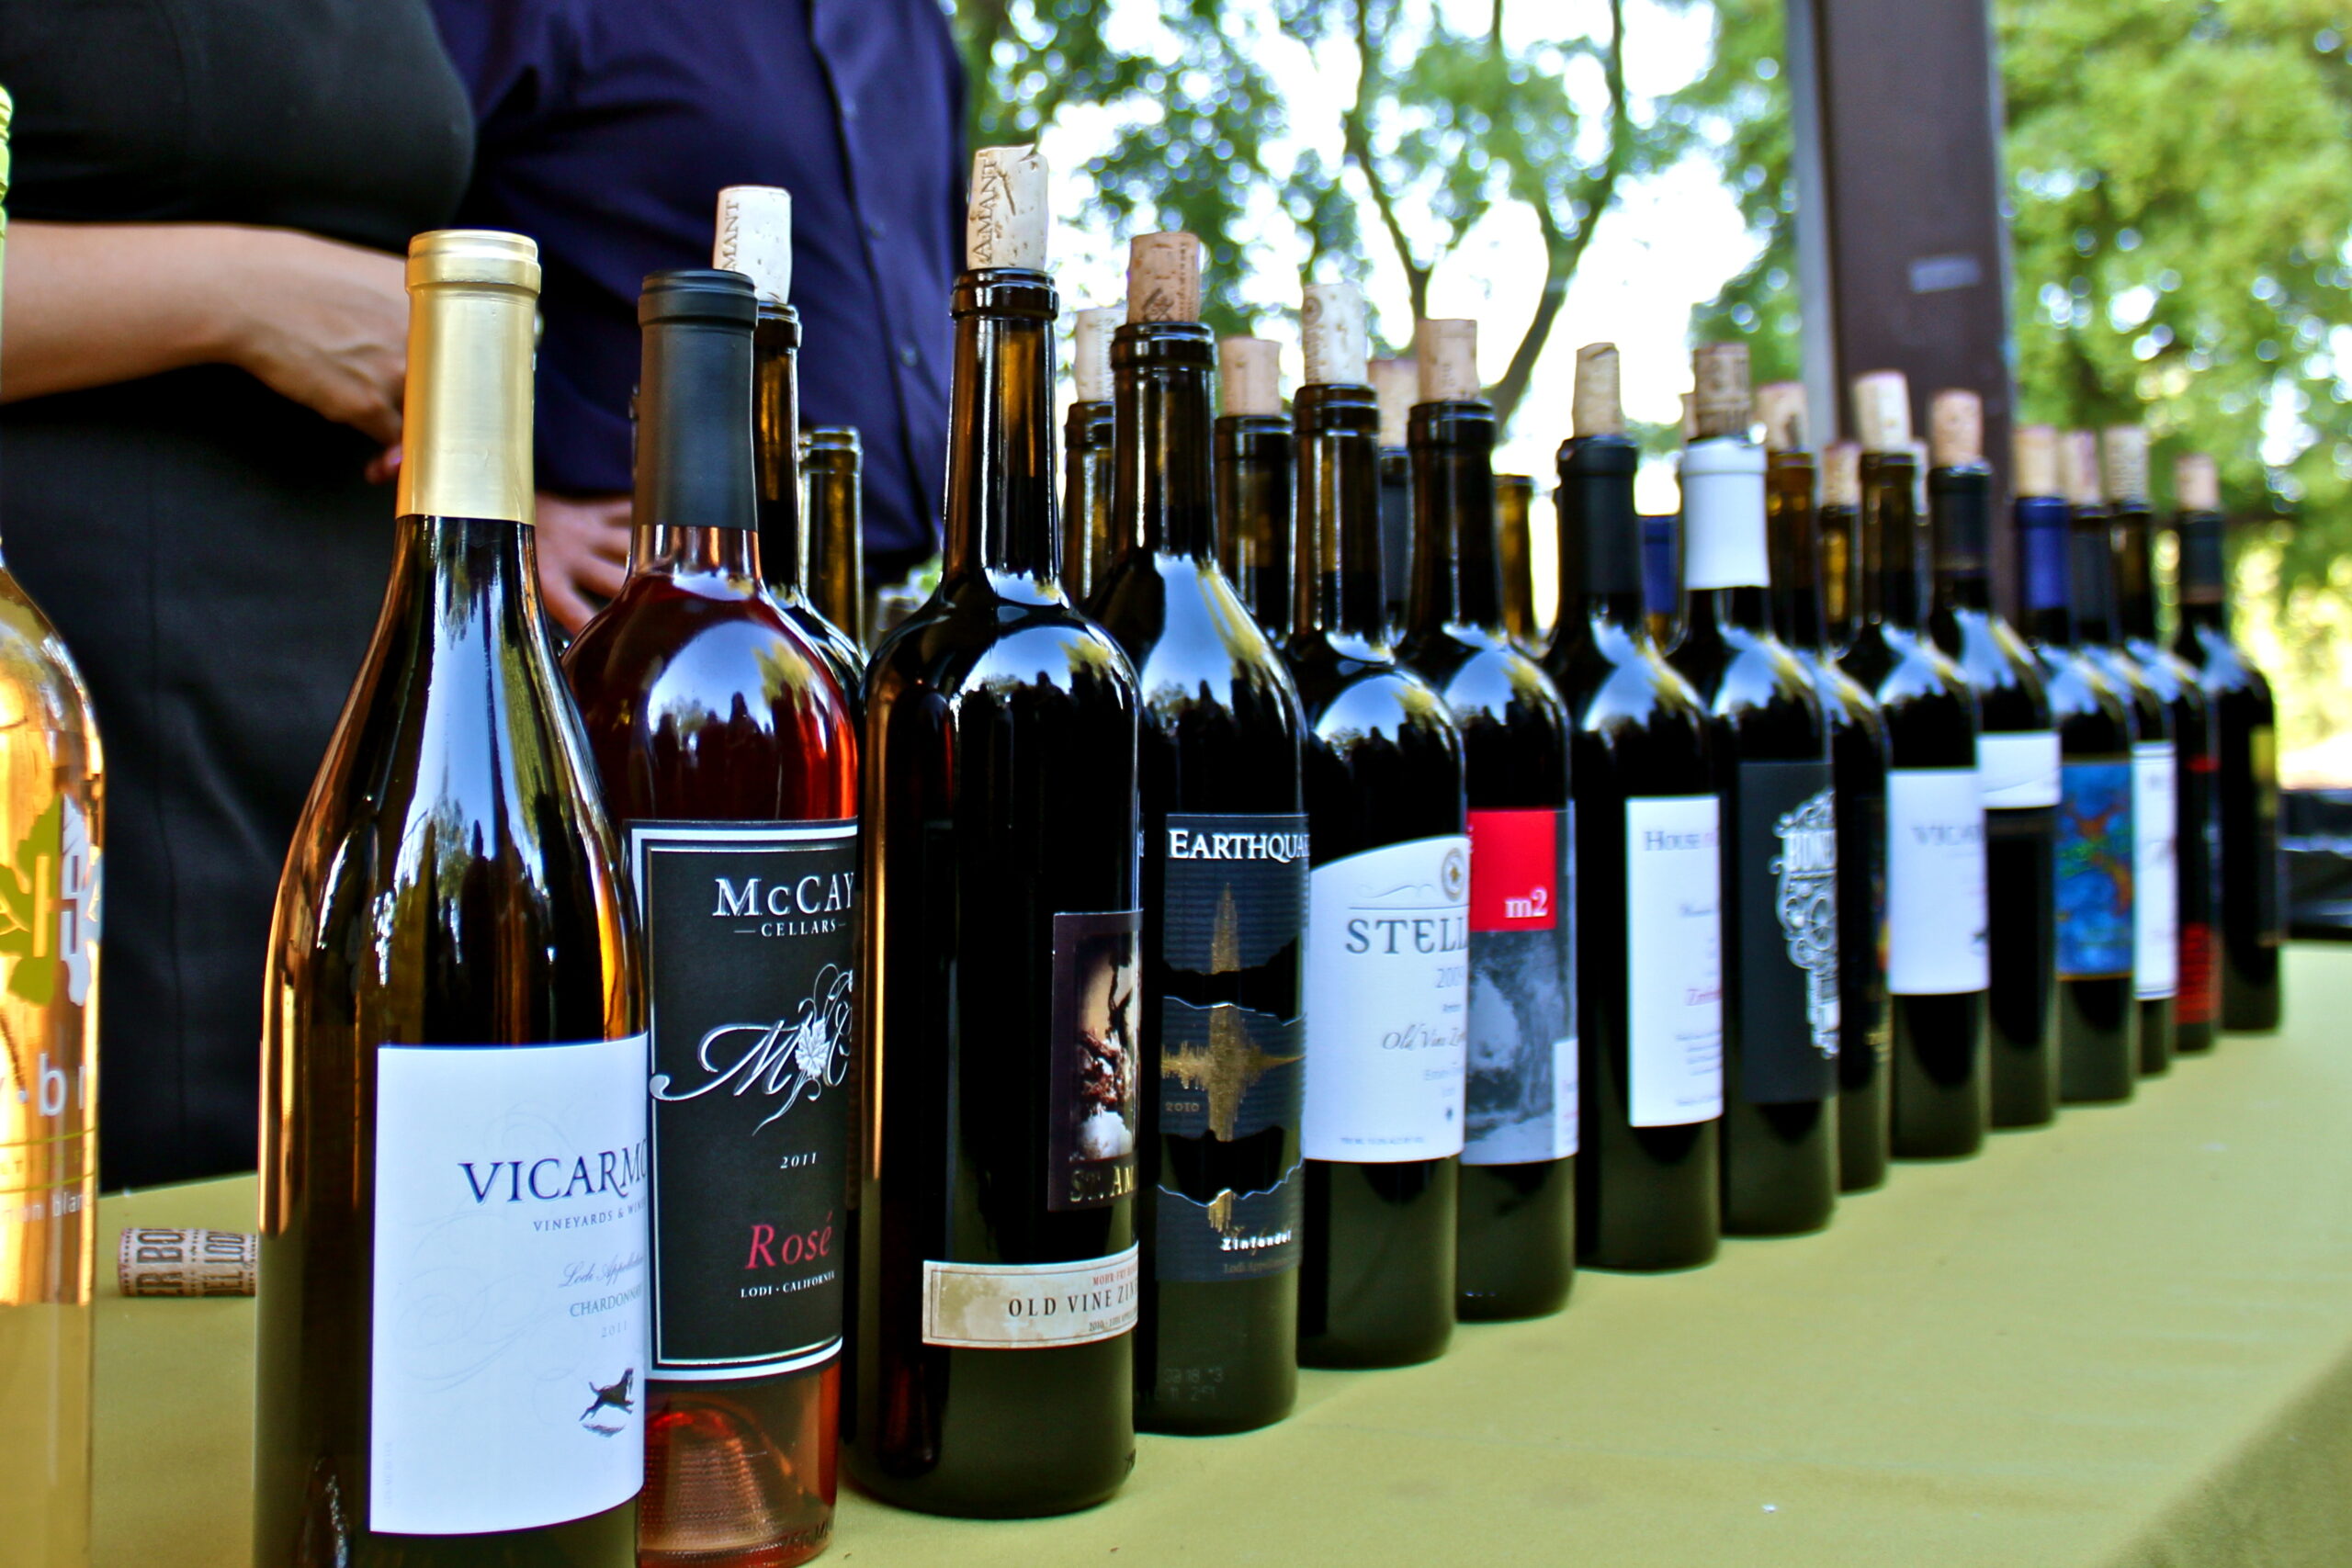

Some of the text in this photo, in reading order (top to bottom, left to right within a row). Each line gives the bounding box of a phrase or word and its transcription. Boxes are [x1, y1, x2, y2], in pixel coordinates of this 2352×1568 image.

[973, 159, 997, 266] AMANT
[1505, 886, 1547, 919] m2
[761, 919, 835, 938] CELLARS
[780, 1151, 818, 1169] 2011
[533, 1210, 613, 1232] VINEYARDS
[744, 1209, 834, 1270] Rosé
[1220, 1228, 1292, 1251] Zinfandel
[558, 1261, 596, 1288] Lodi
[741, 1286, 772, 1299] LODI
[1008, 1297, 1057, 1317] OLD
[1067, 1289, 1113, 1314] VINE
[601, 1321, 628, 1338] 2011
